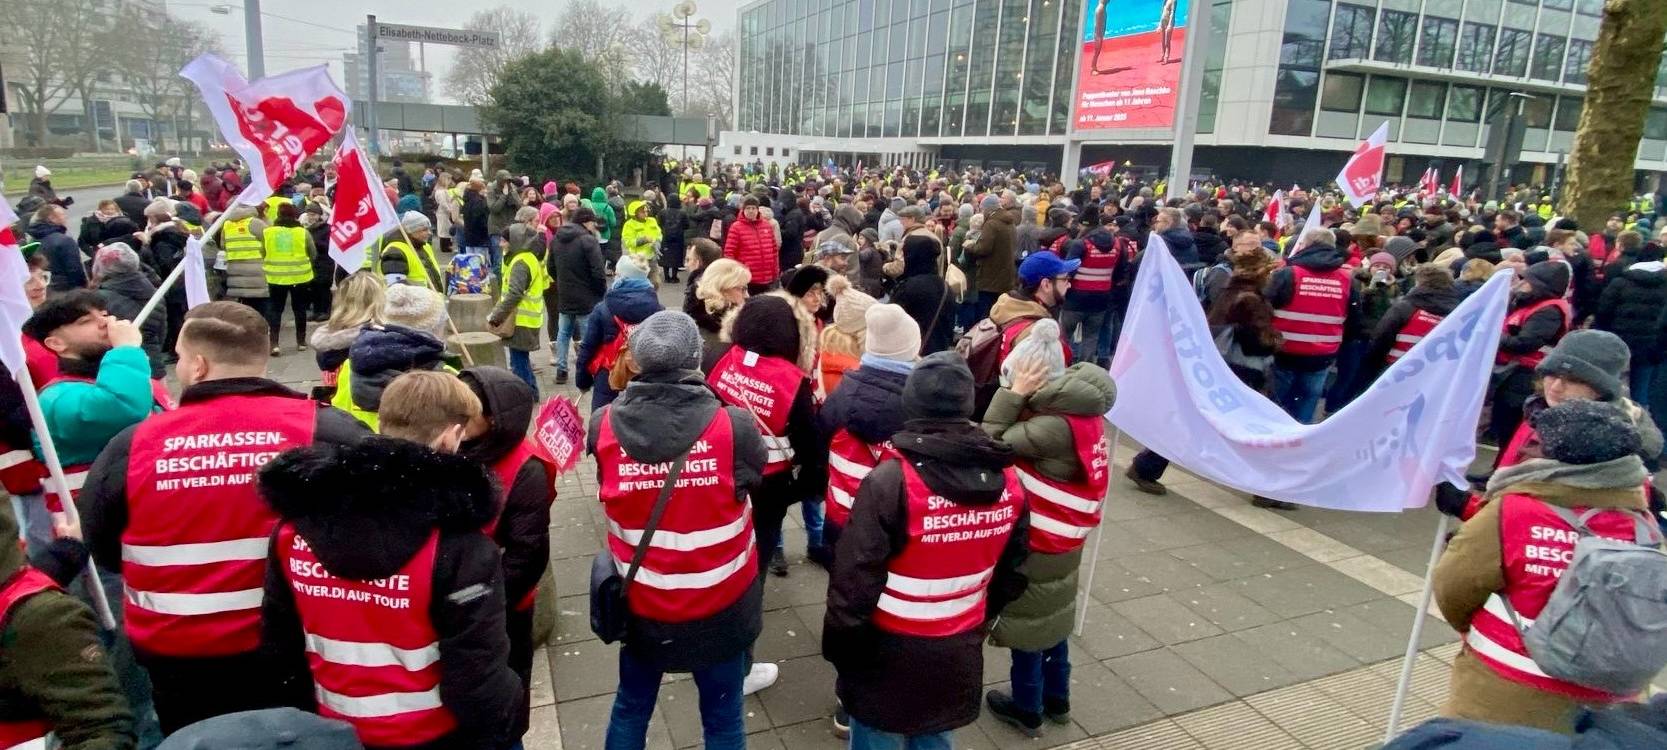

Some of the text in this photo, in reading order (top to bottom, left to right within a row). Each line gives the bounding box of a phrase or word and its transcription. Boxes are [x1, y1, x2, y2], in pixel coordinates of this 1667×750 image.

[379, 26, 495, 47] Elisabeth-Nettebeck-Platz
[163, 431, 287, 453] SPARKASSEN-
[155, 452, 281, 474] BESCHÄFTIGT
[156, 473, 252, 491] MIT VER.DI AUF
[691, 476, 719, 487] TOUR
[923, 505, 1013, 531] BESCHÄFTIGTE
[921, 522, 1012, 543] MIT VER.DI AUF TOUR
[1525, 563, 1551, 576] MIT
[304, 585, 346, 600] VER.DI
[346, 589, 372, 603] AUF
[373, 593, 410, 609] TOUR
